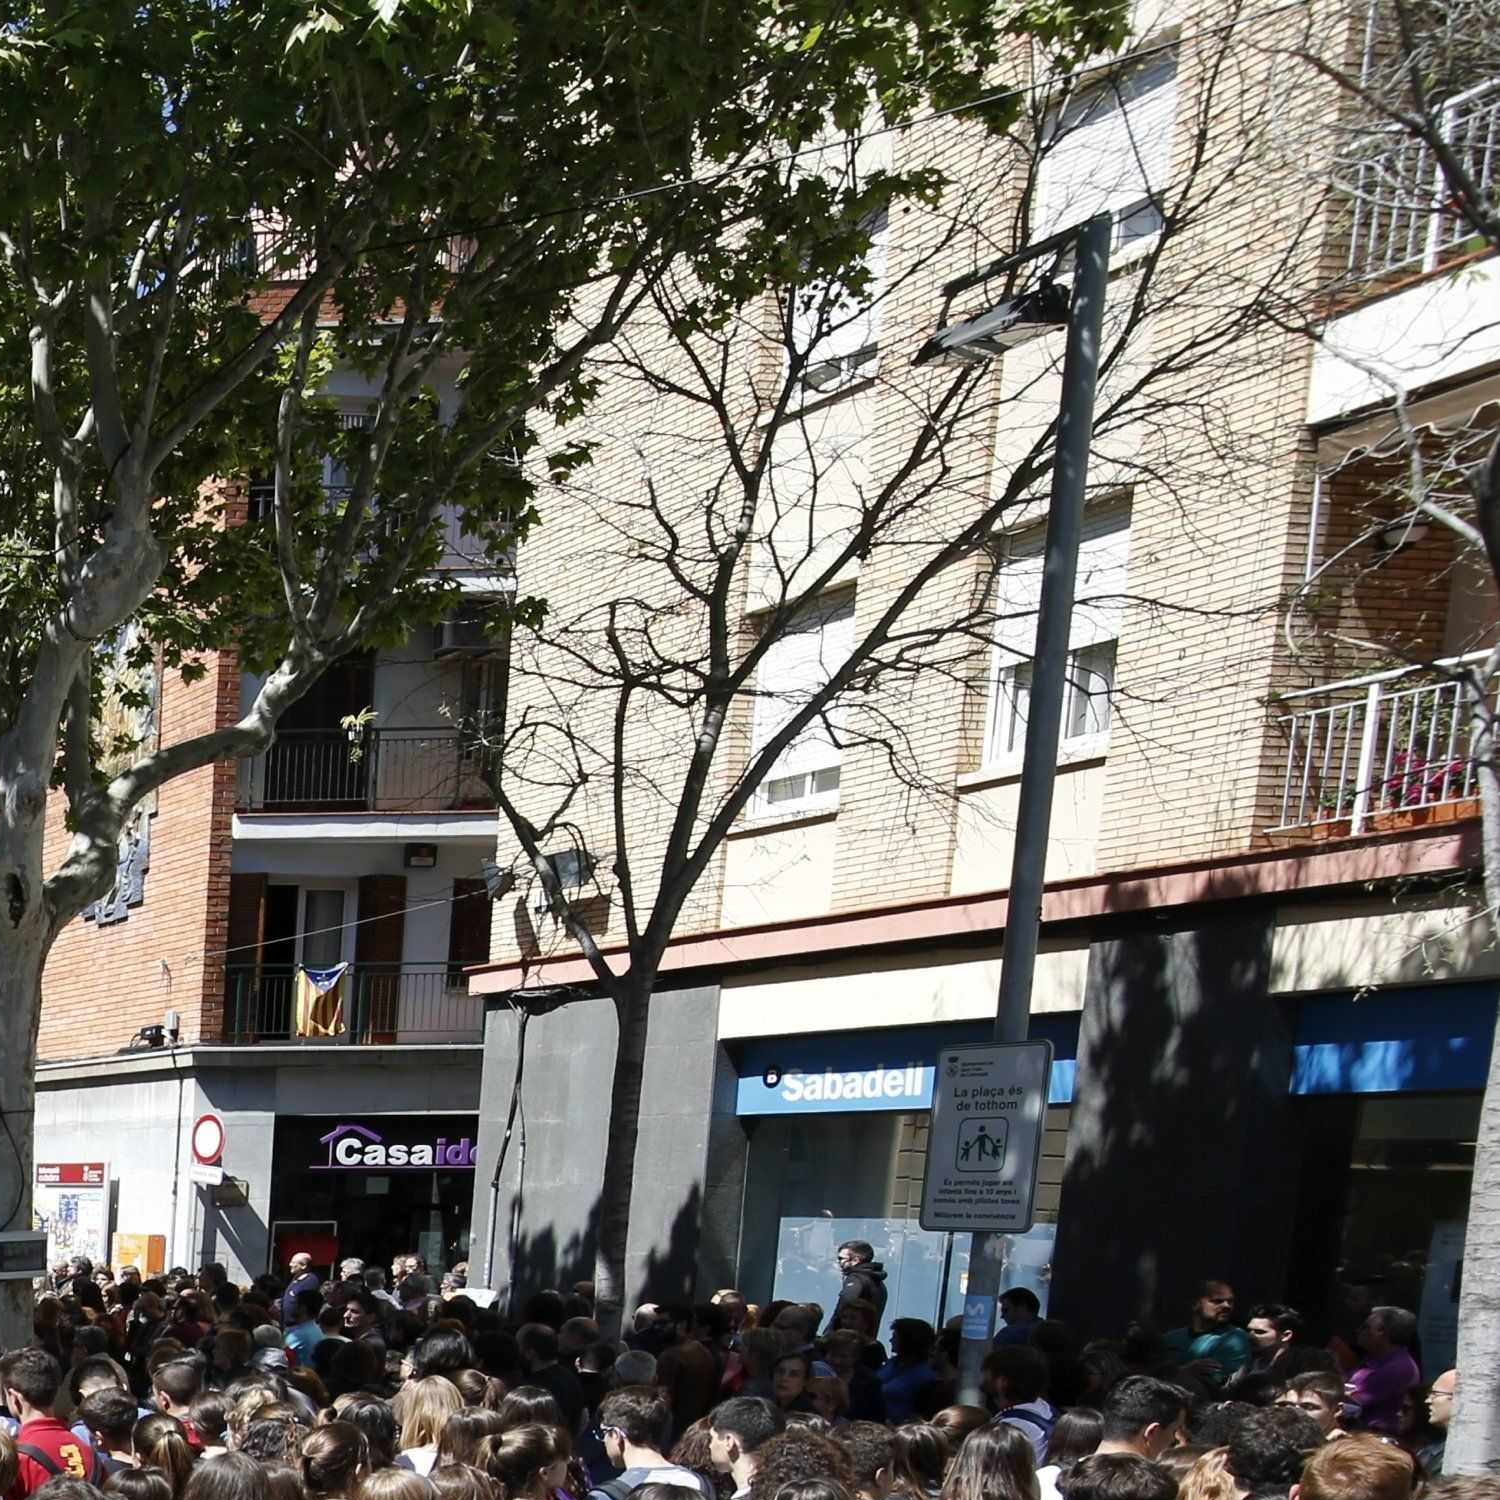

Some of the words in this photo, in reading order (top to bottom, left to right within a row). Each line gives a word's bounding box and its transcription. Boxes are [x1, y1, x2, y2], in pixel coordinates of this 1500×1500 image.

[782, 1062, 924, 1101] Sabadell
[954, 1087, 968, 1098] La
[971, 1086, 1004, 1099] plaça
[1007, 1085, 1023, 1096] és
[956, 1101, 972, 1111] de
[974, 1100, 1018, 1111] tothom
[60, 1444, 86, 1479] 3
